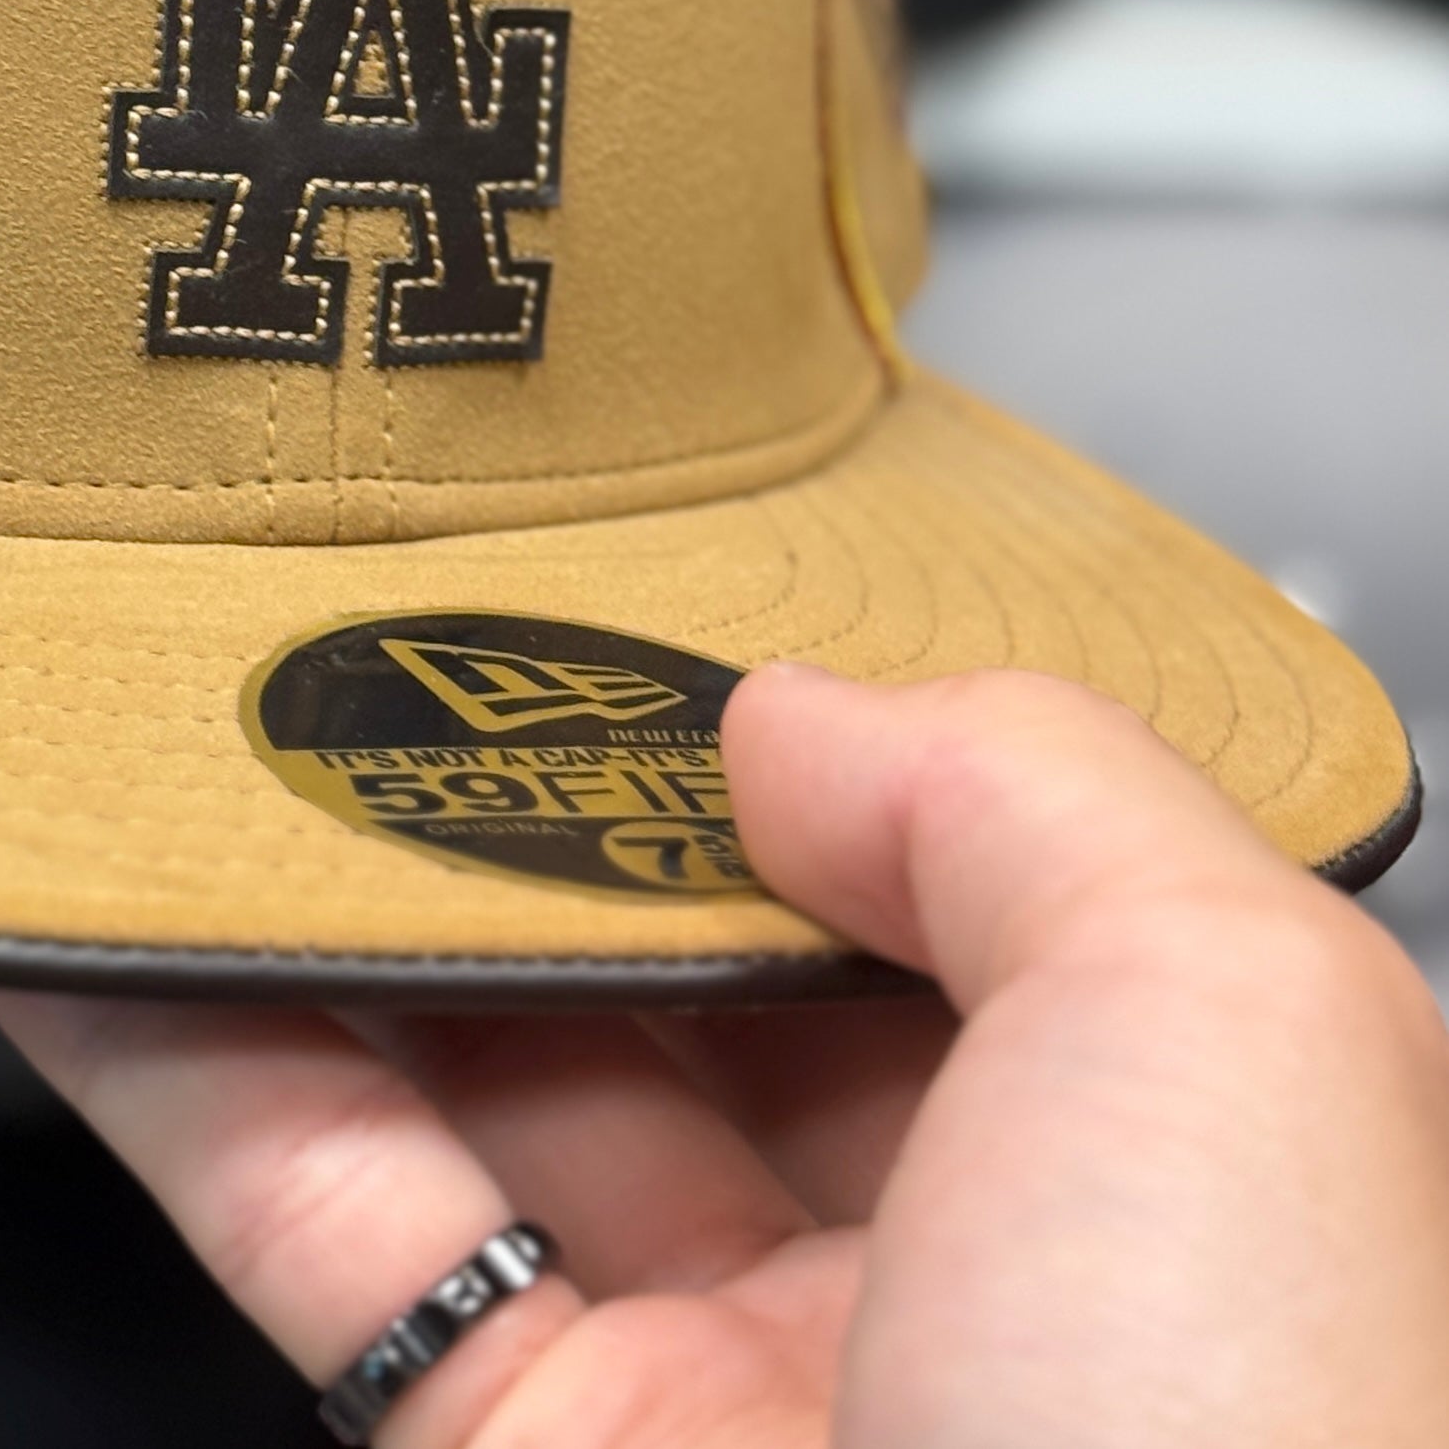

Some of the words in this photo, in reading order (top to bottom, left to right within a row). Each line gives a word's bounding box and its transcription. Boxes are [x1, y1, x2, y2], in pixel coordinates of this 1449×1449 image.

[314, 750, 399, 768] IT'S
[402, 748, 486, 768] NOT
[498, 749, 531, 767] A
[349, 770, 728, 815] 59FIF
[424, 822, 579, 836] ORIGINAL
[611, 836, 689, 880] 7
